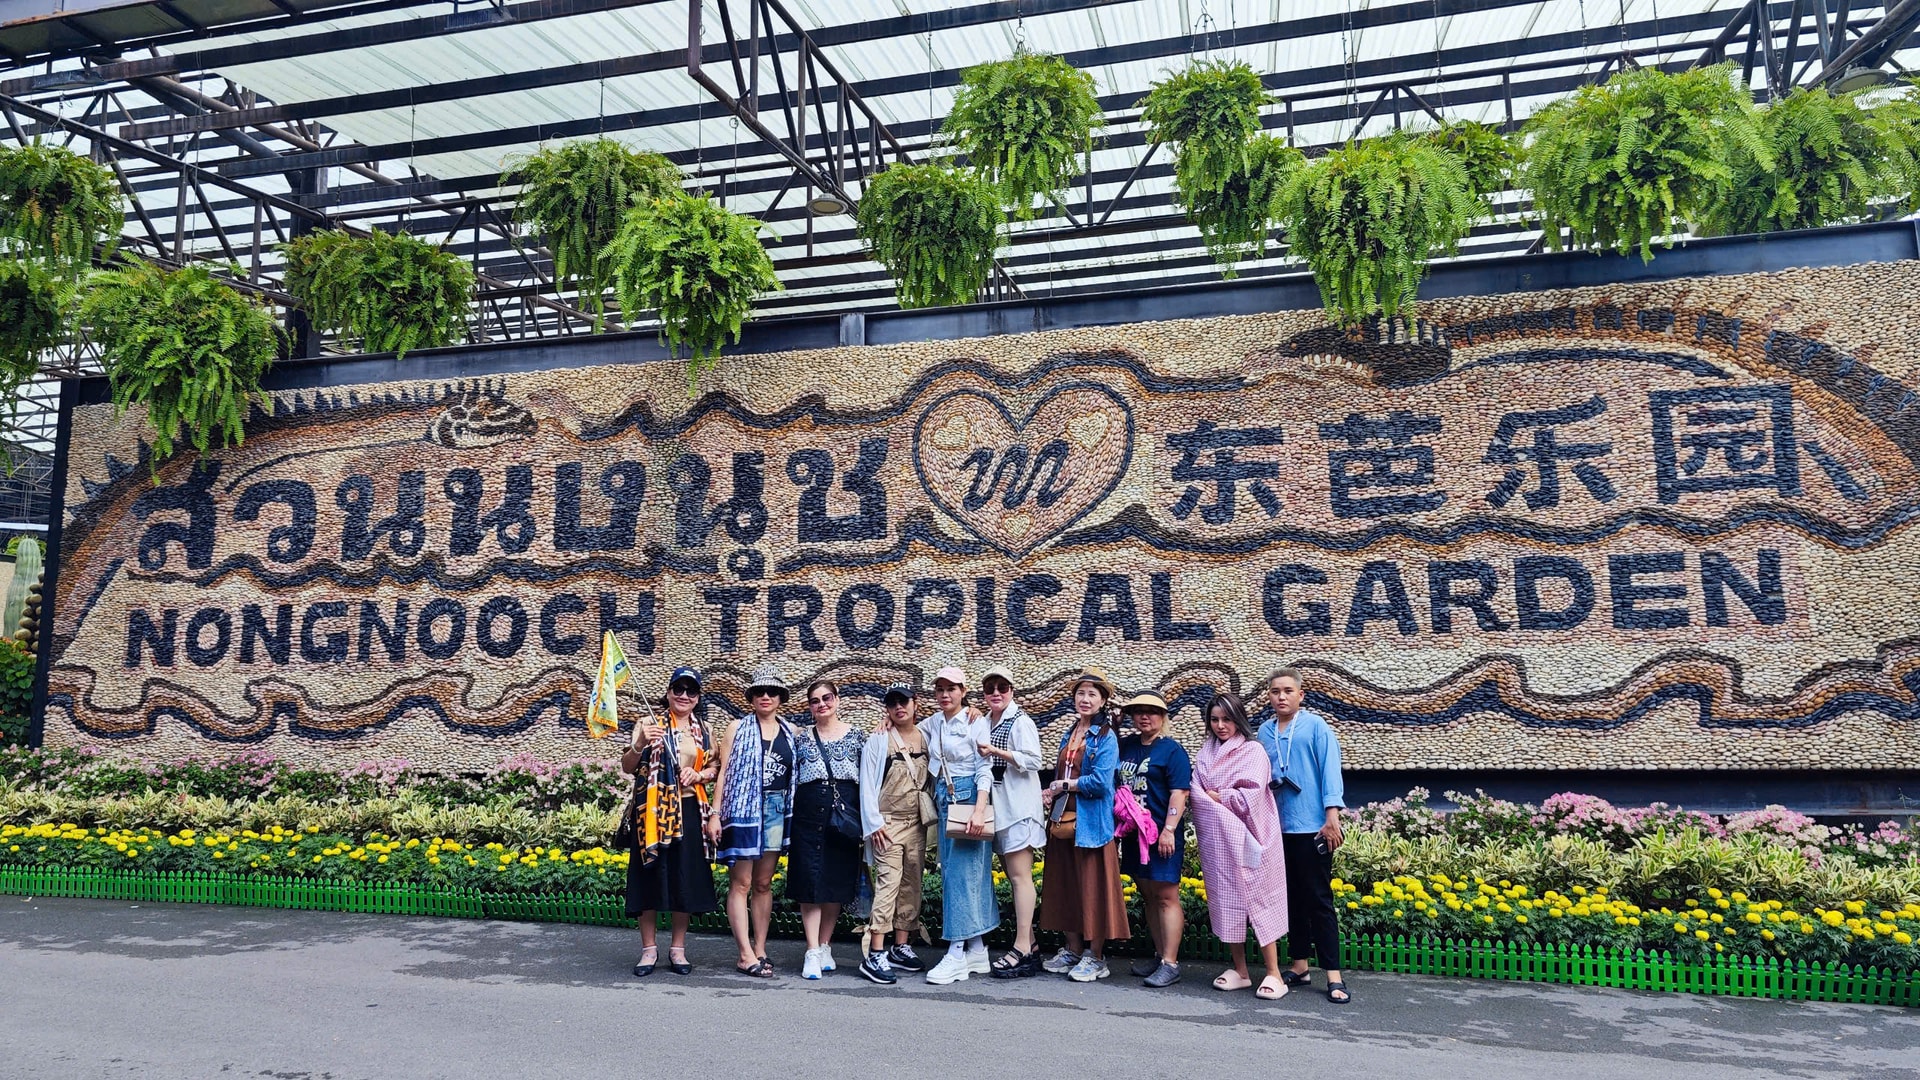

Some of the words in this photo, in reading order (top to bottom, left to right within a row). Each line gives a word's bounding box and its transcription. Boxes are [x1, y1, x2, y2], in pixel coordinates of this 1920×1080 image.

[131, 437, 888, 580] สวนนงนุช
[1166, 383, 1803, 525] 东芭乐园
[124, 591, 657, 668] NONGNOOCH
[703, 571, 1216, 653] TROPICAL
[1262, 549, 1788, 637] GARDEN
